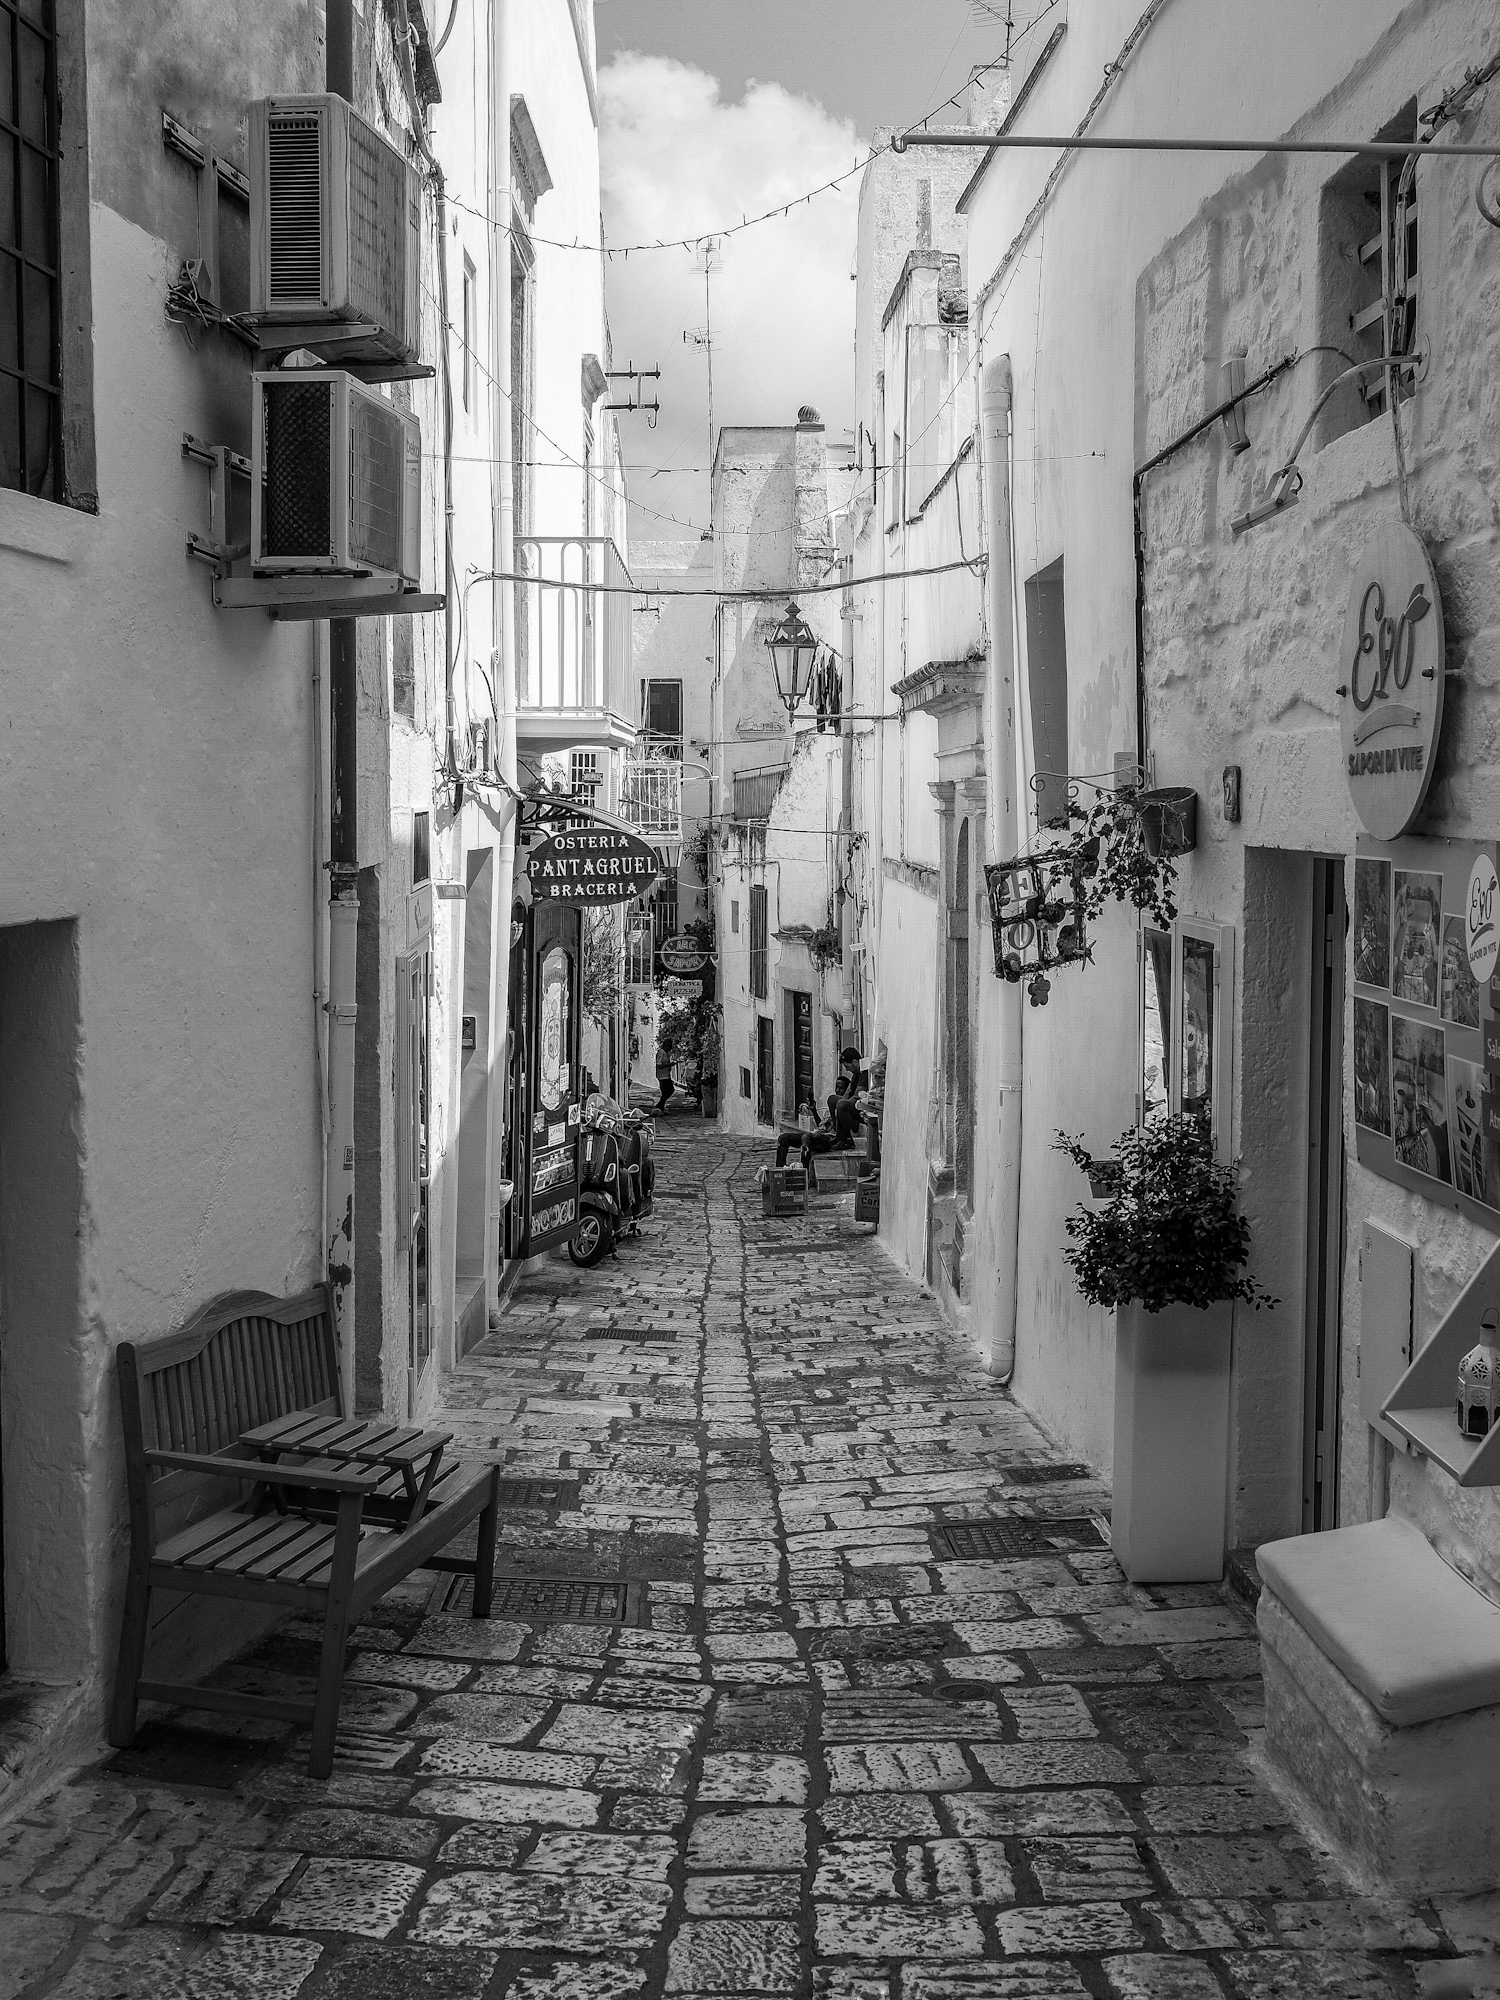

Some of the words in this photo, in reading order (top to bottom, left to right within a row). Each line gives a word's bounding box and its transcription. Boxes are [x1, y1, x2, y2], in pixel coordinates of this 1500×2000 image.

[406, 437, 420, 459] beko
[1348, 750, 1385, 776] SAPORI
[1385, 748, 1398, 774] DI
[1397, 745, 1424, 771] VITE
[554, 835, 629, 850] OSTERIA
[529, 856, 657, 877] PANTAGRUEL
[549, 882, 638, 897] BRACERIA
[667, 954, 703, 969] SAPORI
[1469, 948, 1483, 963] SAPORI
[1487, 941, 1497, 954] VITE
